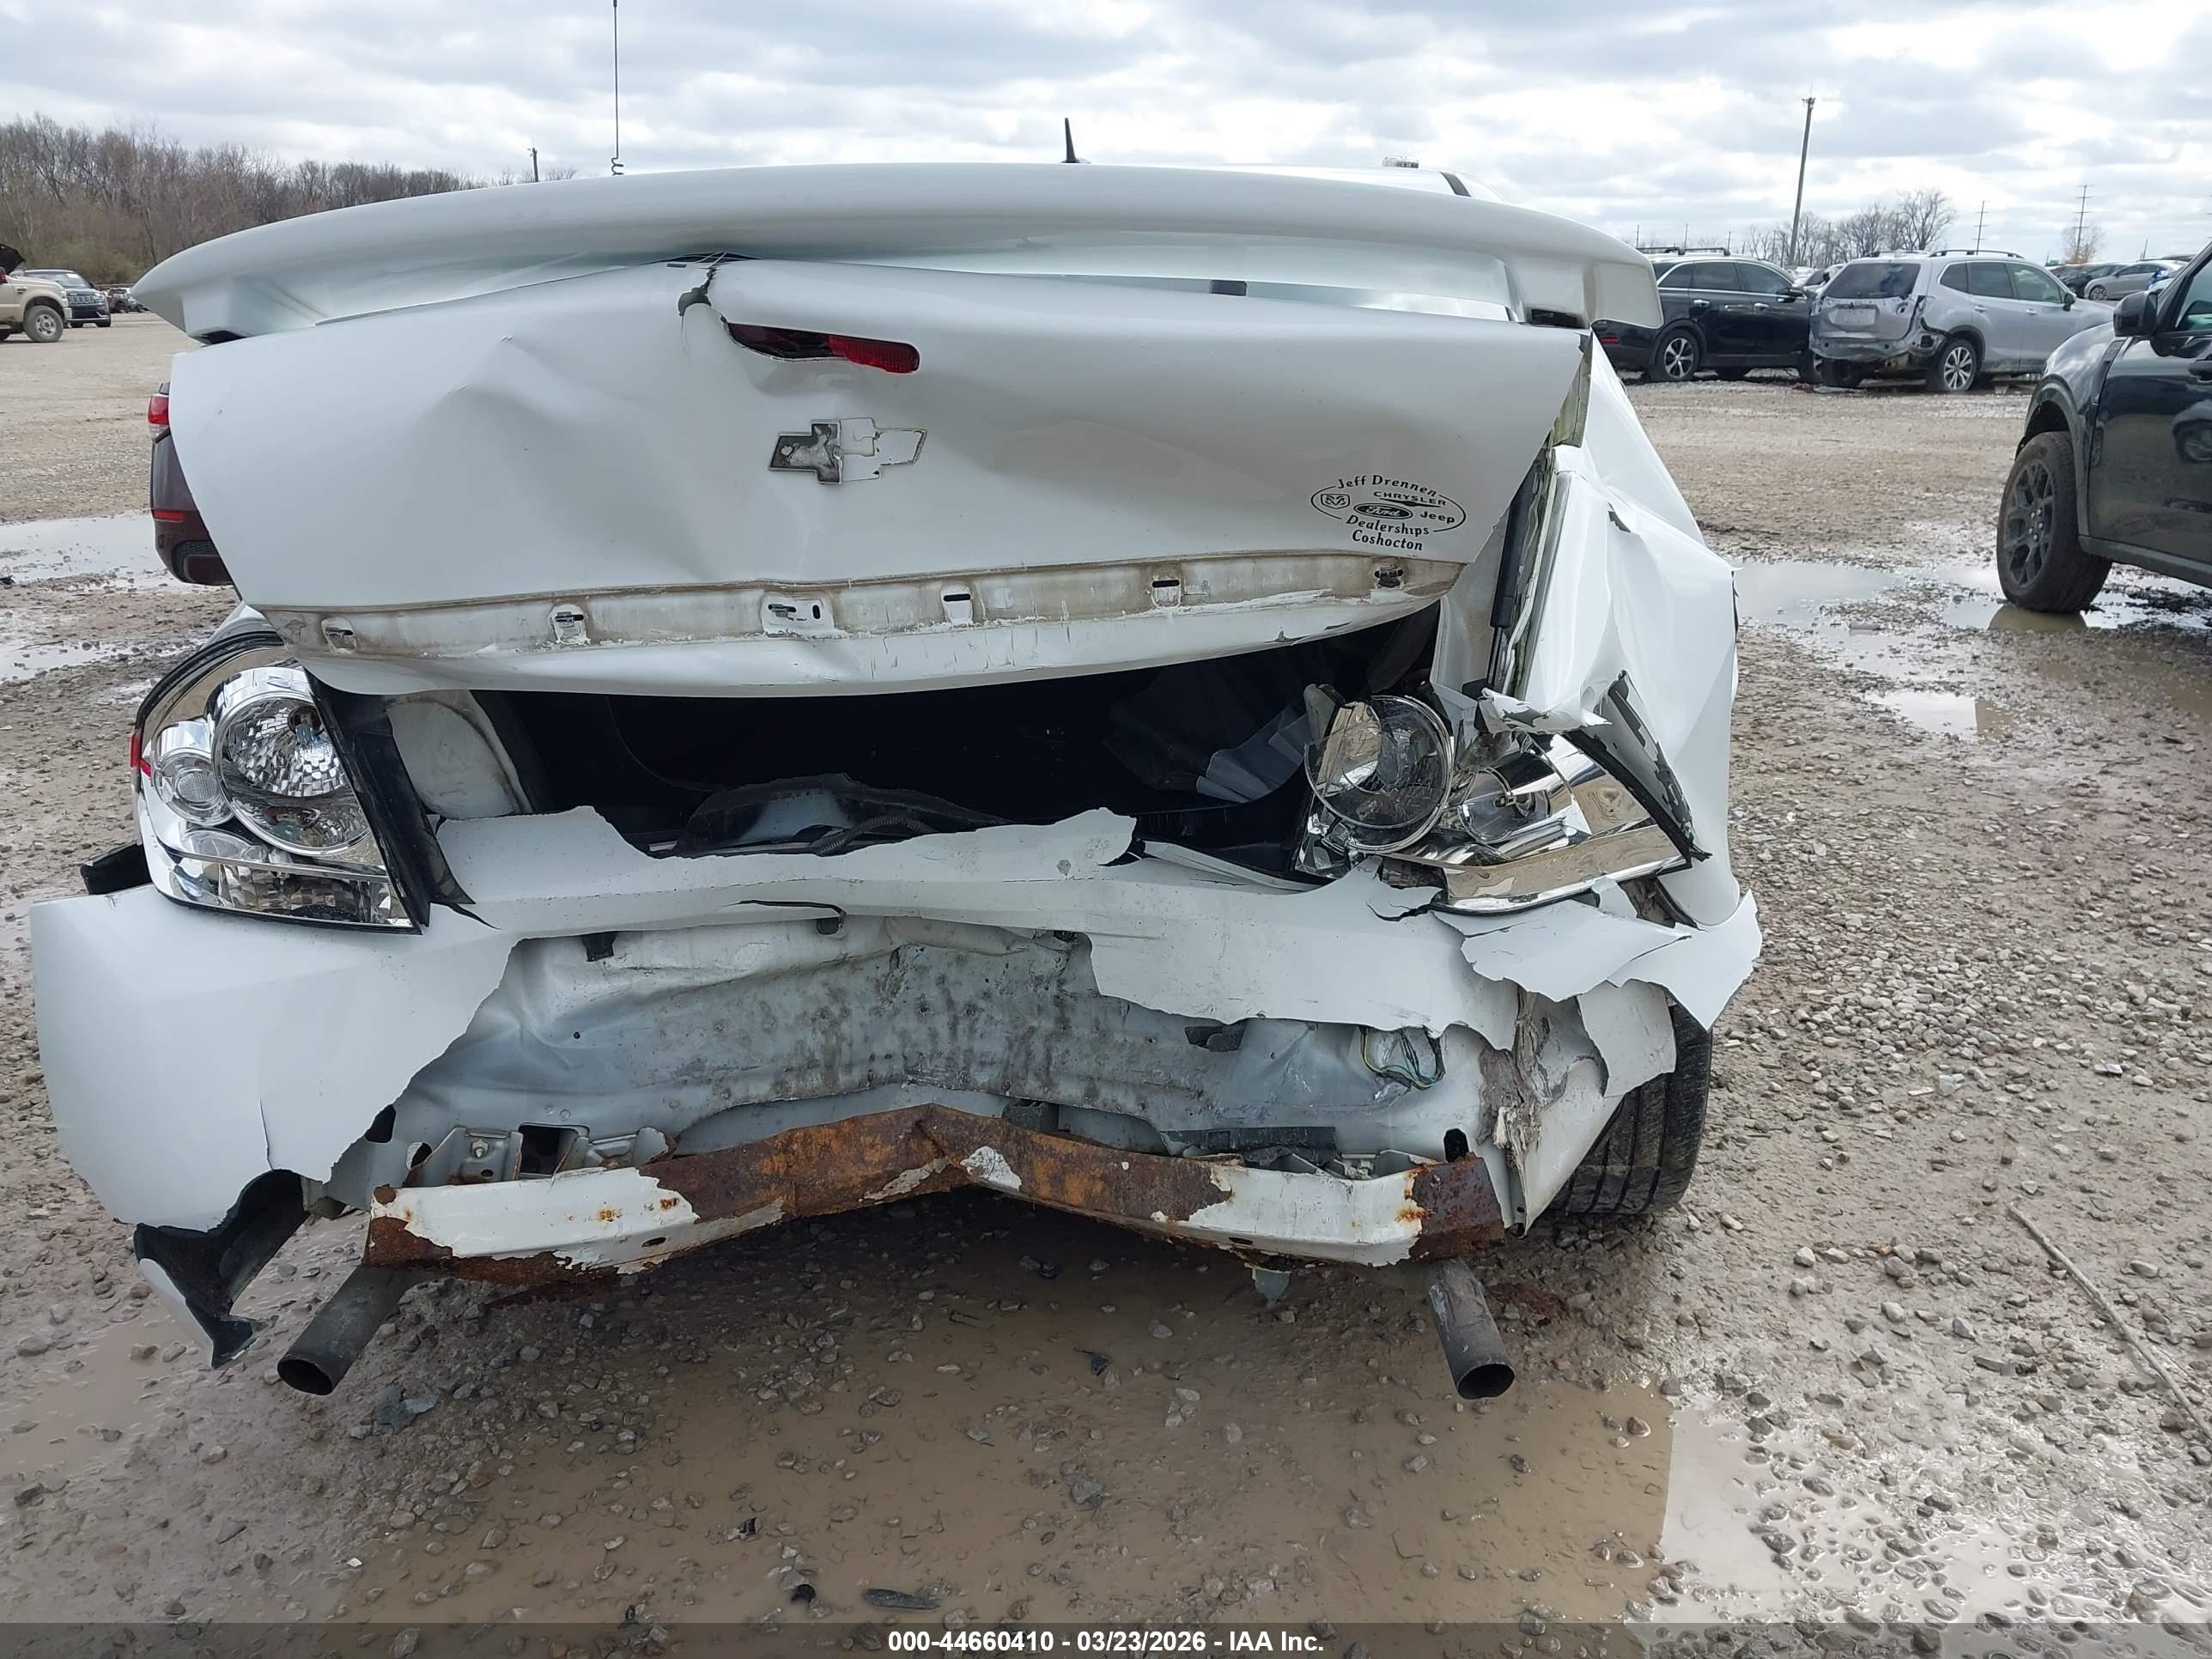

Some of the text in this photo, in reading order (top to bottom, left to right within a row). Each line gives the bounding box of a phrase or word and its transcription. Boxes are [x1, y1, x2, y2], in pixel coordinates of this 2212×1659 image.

[1337, 474, 1441, 497] Jeff Drennen
[1373, 491, 1447, 507] CHRYSLER
[1346, 514, 1430, 537] Dealerships
[1419, 511, 1455, 525] Jeep
[1352, 529, 1423, 550] Coshocton
